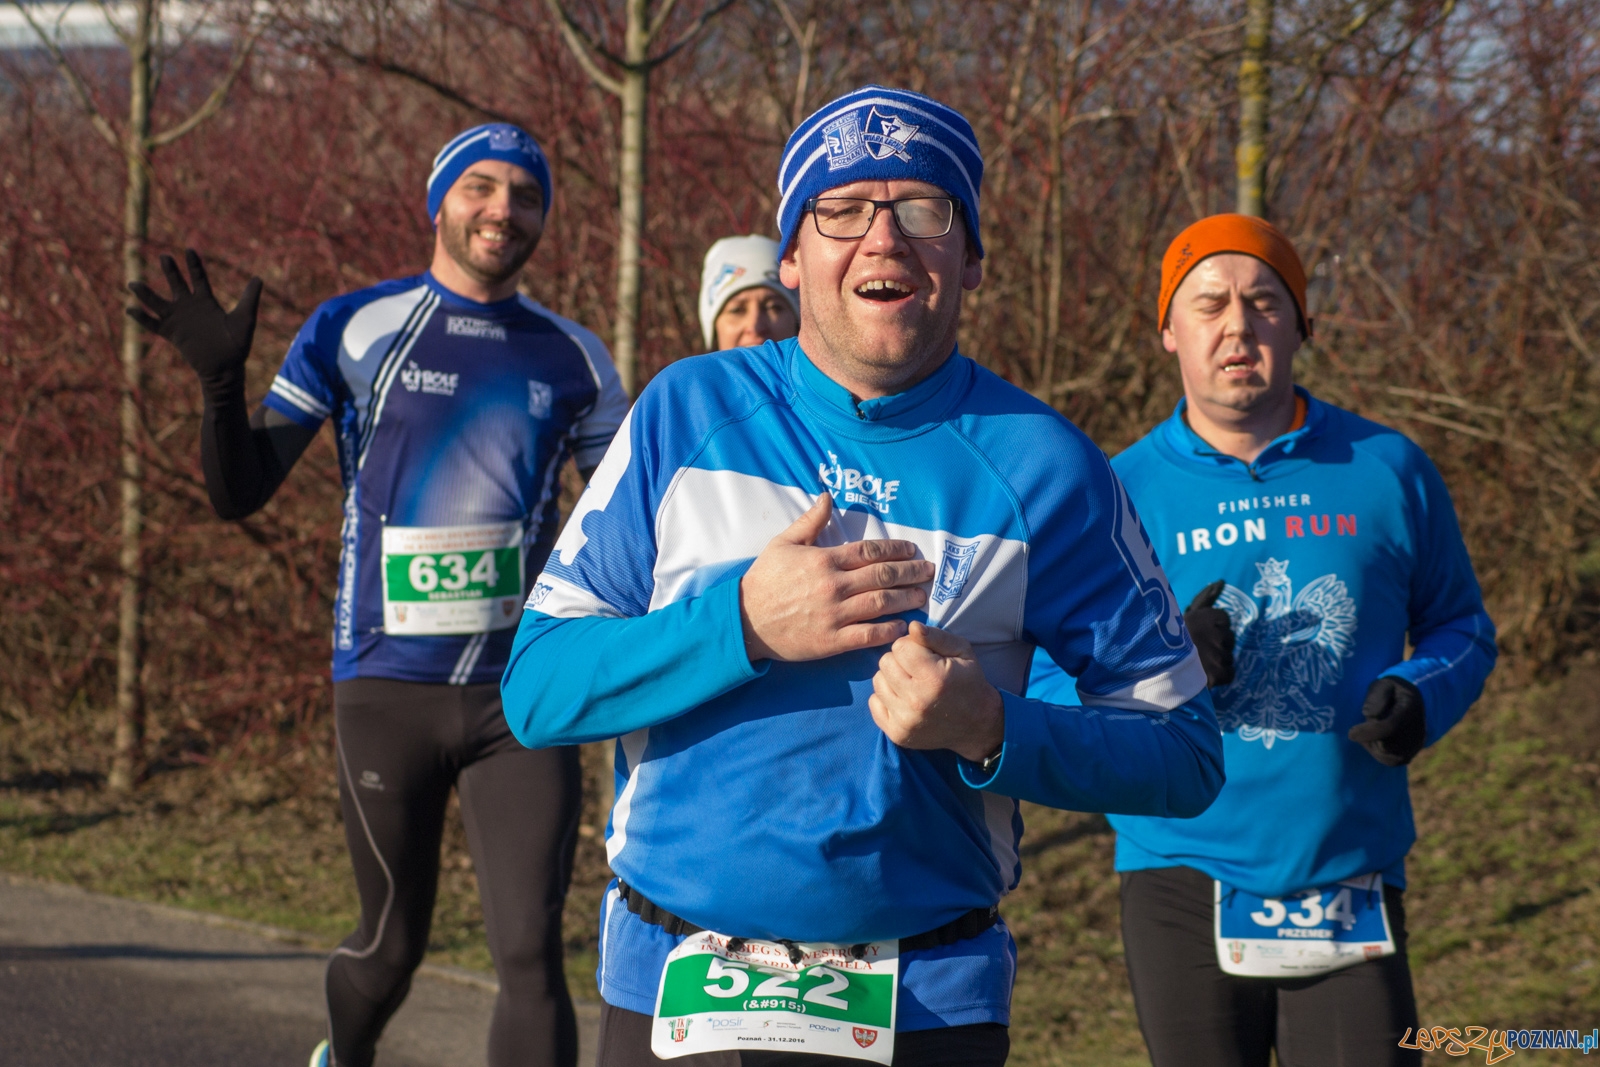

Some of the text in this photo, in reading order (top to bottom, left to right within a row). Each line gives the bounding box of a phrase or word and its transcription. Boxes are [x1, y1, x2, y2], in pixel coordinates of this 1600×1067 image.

[844, 492, 890, 514] BIEGU
[1218, 494, 1311, 514] FINISHER
[1176, 514, 1358, 555] IRON RUN
[408, 551, 500, 592] 634
[1277, 927, 1334, 938] PRZEMEK
[703, 957, 850, 1011] 522
[742, 1000, 806, 1013] (&#915;)
[712, 1017, 744, 1028] posir
